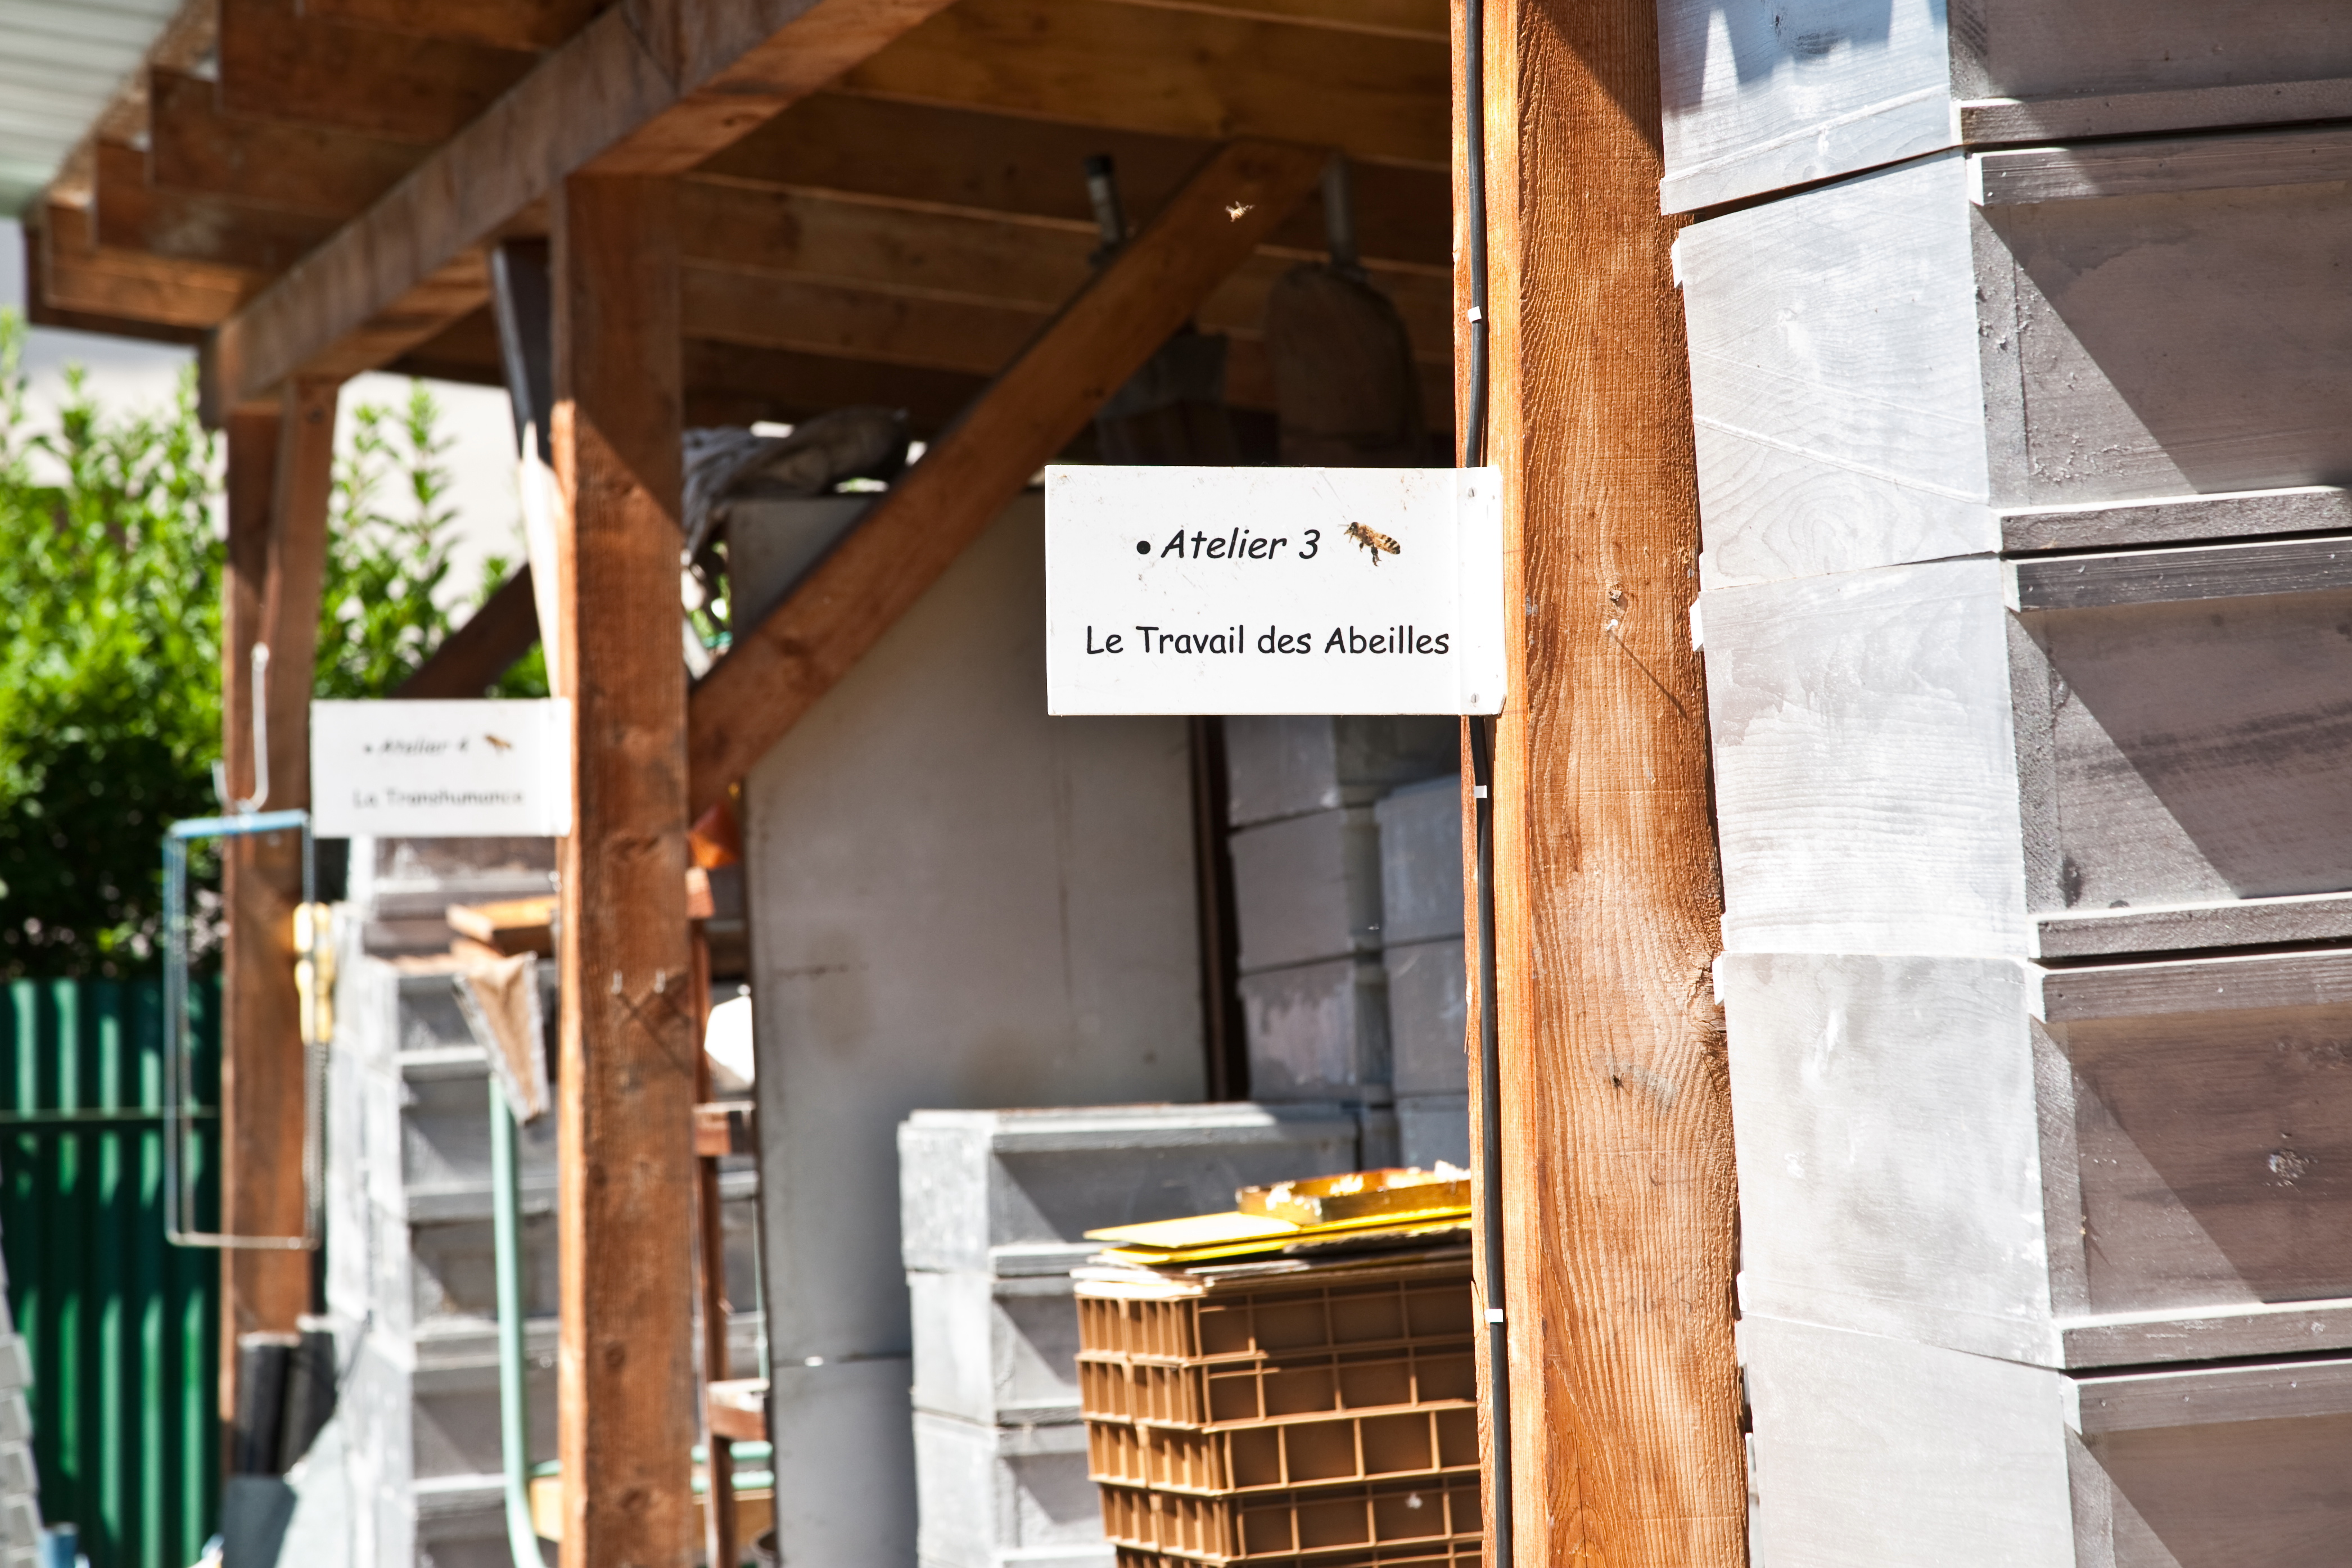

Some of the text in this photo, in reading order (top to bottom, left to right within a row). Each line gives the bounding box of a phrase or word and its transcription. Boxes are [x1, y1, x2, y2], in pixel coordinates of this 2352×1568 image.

[1160, 526, 1321, 560] Atelier 3
[1086, 624, 1450, 655] Le Travail des Abeilles
[380, 737, 449, 755] Atelier
[353, 786, 524, 808] La Transhumance
